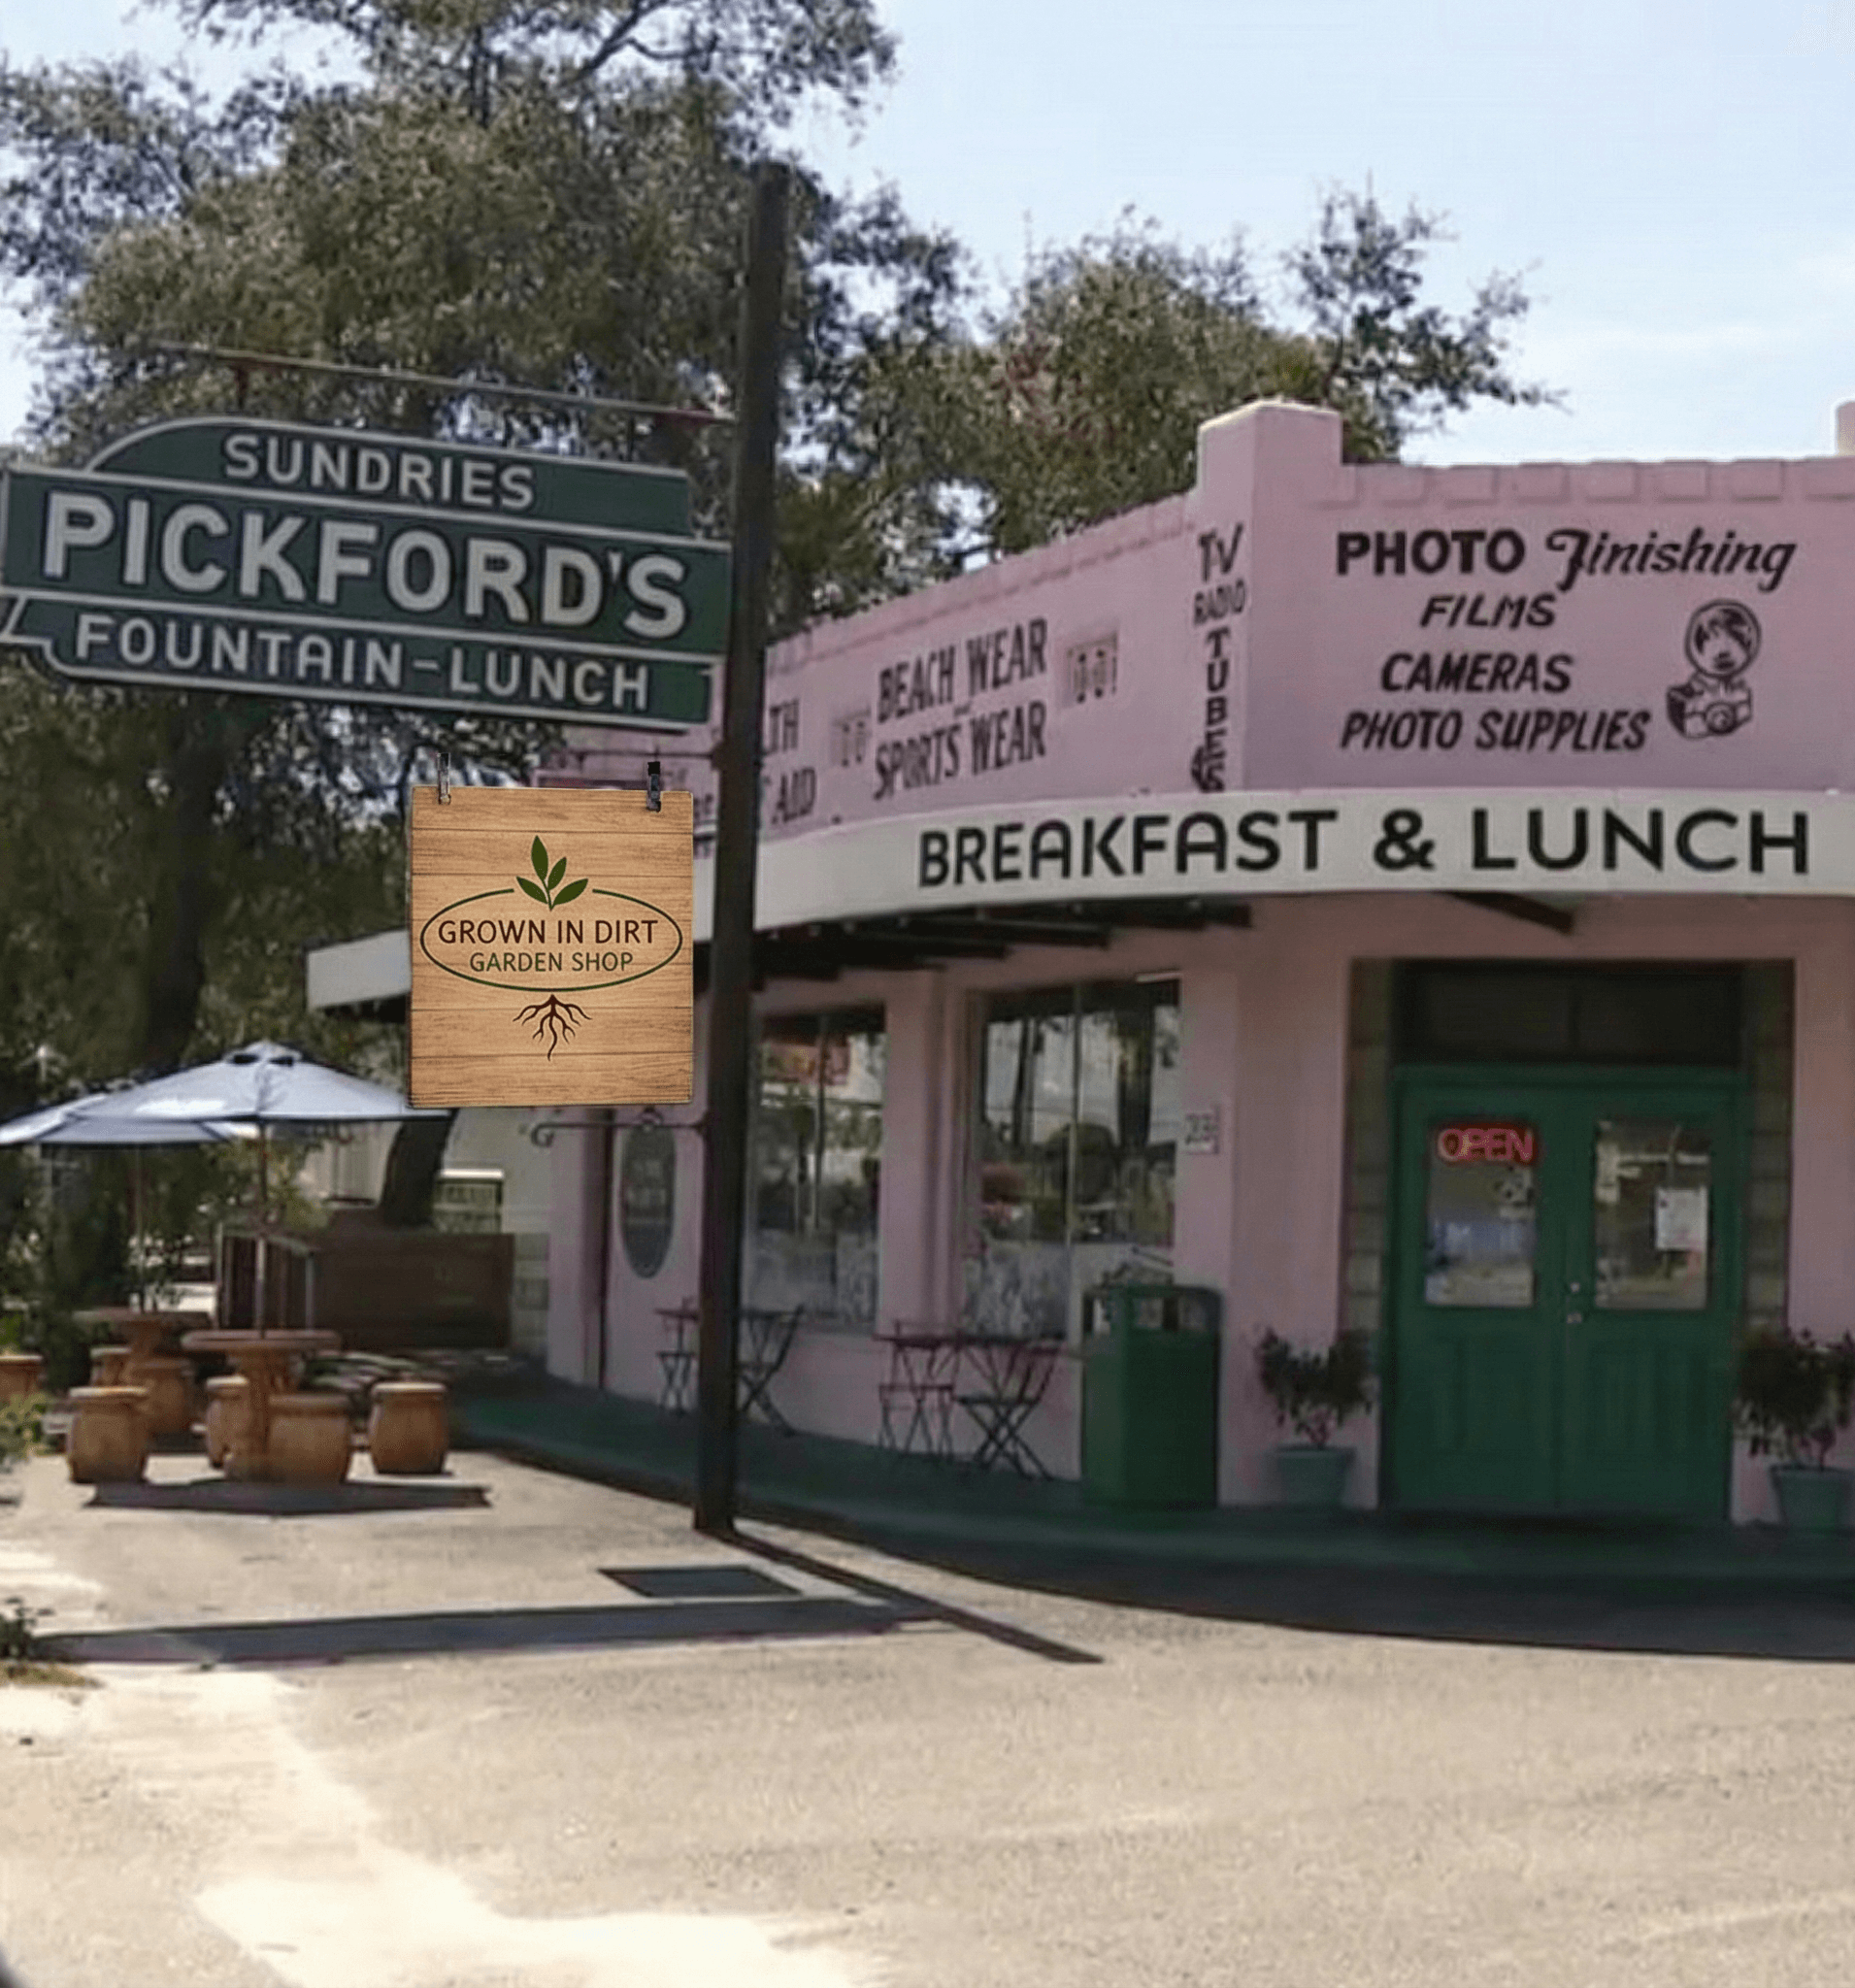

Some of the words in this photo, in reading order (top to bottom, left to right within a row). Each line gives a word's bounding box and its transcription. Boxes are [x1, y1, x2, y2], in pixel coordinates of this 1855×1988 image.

[224, 435, 535, 510] SUNDRIES
[44, 491, 687, 639] PICKFORD'S
[1198, 522, 1243, 582] TV
[1336, 529, 1527, 576] PHOTO
[1545, 527, 1797, 592] Finishing
[1193, 579, 1246, 626] RADIO
[1419, 592, 1558, 629] FILMS
[878, 644, 956, 725] BEACH
[966, 616, 1048, 698] WEAR
[1379, 651, 1574, 693] CAMERAS
[1204, 625, 1231, 794] TUBES
[1340, 710, 1463, 751] PHOTO
[1474, 710, 1653, 752] SUPPLIES
[873, 723, 962, 802] SPORTS
[971, 699, 1046, 777] WEAR
[918, 809, 1340, 889] BREAKFAST
[1373, 808, 1437, 871] &
[1471, 807, 1810, 875] LUNCH
[438, 920, 546, 944] GROWN
[556, 920, 583, 944] IN
[595, 920, 659, 944] DIRT
[469, 951, 562, 973] GARDEN
[572, 951, 634, 973] SHOP
[1438, 1127, 1534, 1161] OPEN
